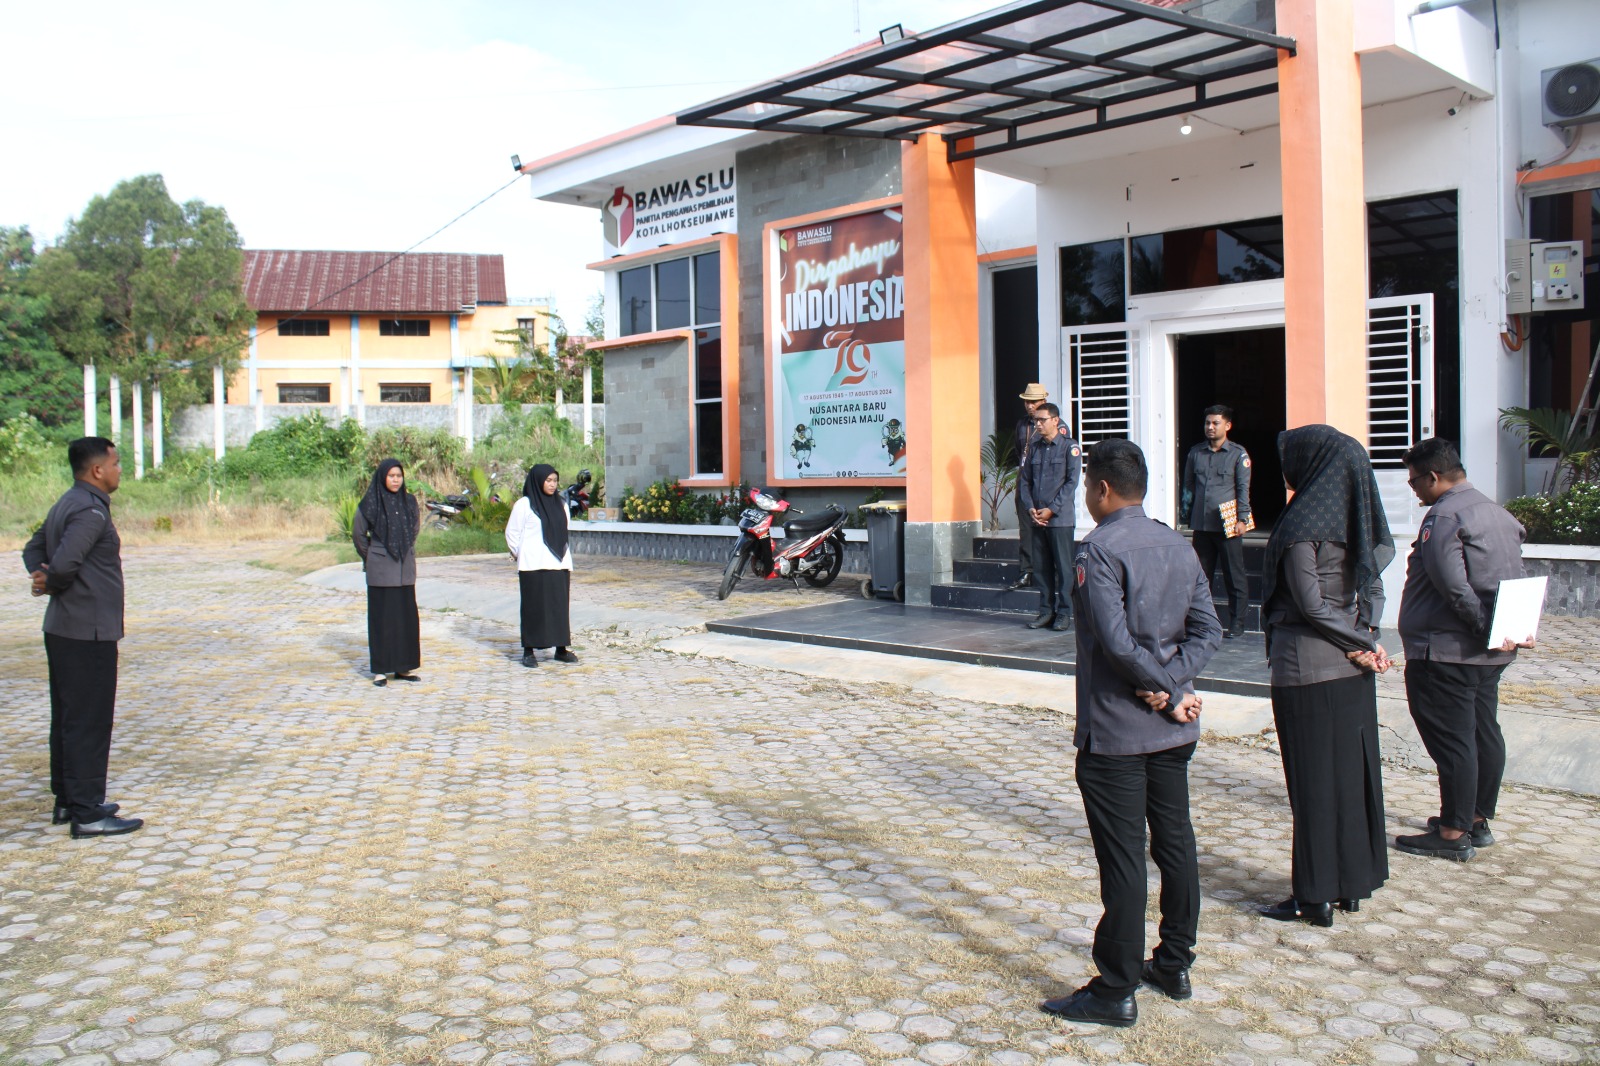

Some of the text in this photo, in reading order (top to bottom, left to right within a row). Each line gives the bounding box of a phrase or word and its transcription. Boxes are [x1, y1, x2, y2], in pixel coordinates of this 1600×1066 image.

[635, 167, 734, 212] BAWASLU
[636, 195, 735, 226] PANITIA PENGAWAS PEMILIHAN
[636, 208, 735, 239] KOTA LHOKSEUMAWE
[797, 225, 832, 241] BAWASLU
[795, 239, 900, 295] Dirgahayu
[809, 393, 832, 401] AGUSTUS
[809, 401, 887, 415] NUSANTARA BARU
[811, 414, 884, 426] INDONESIA MAJU
